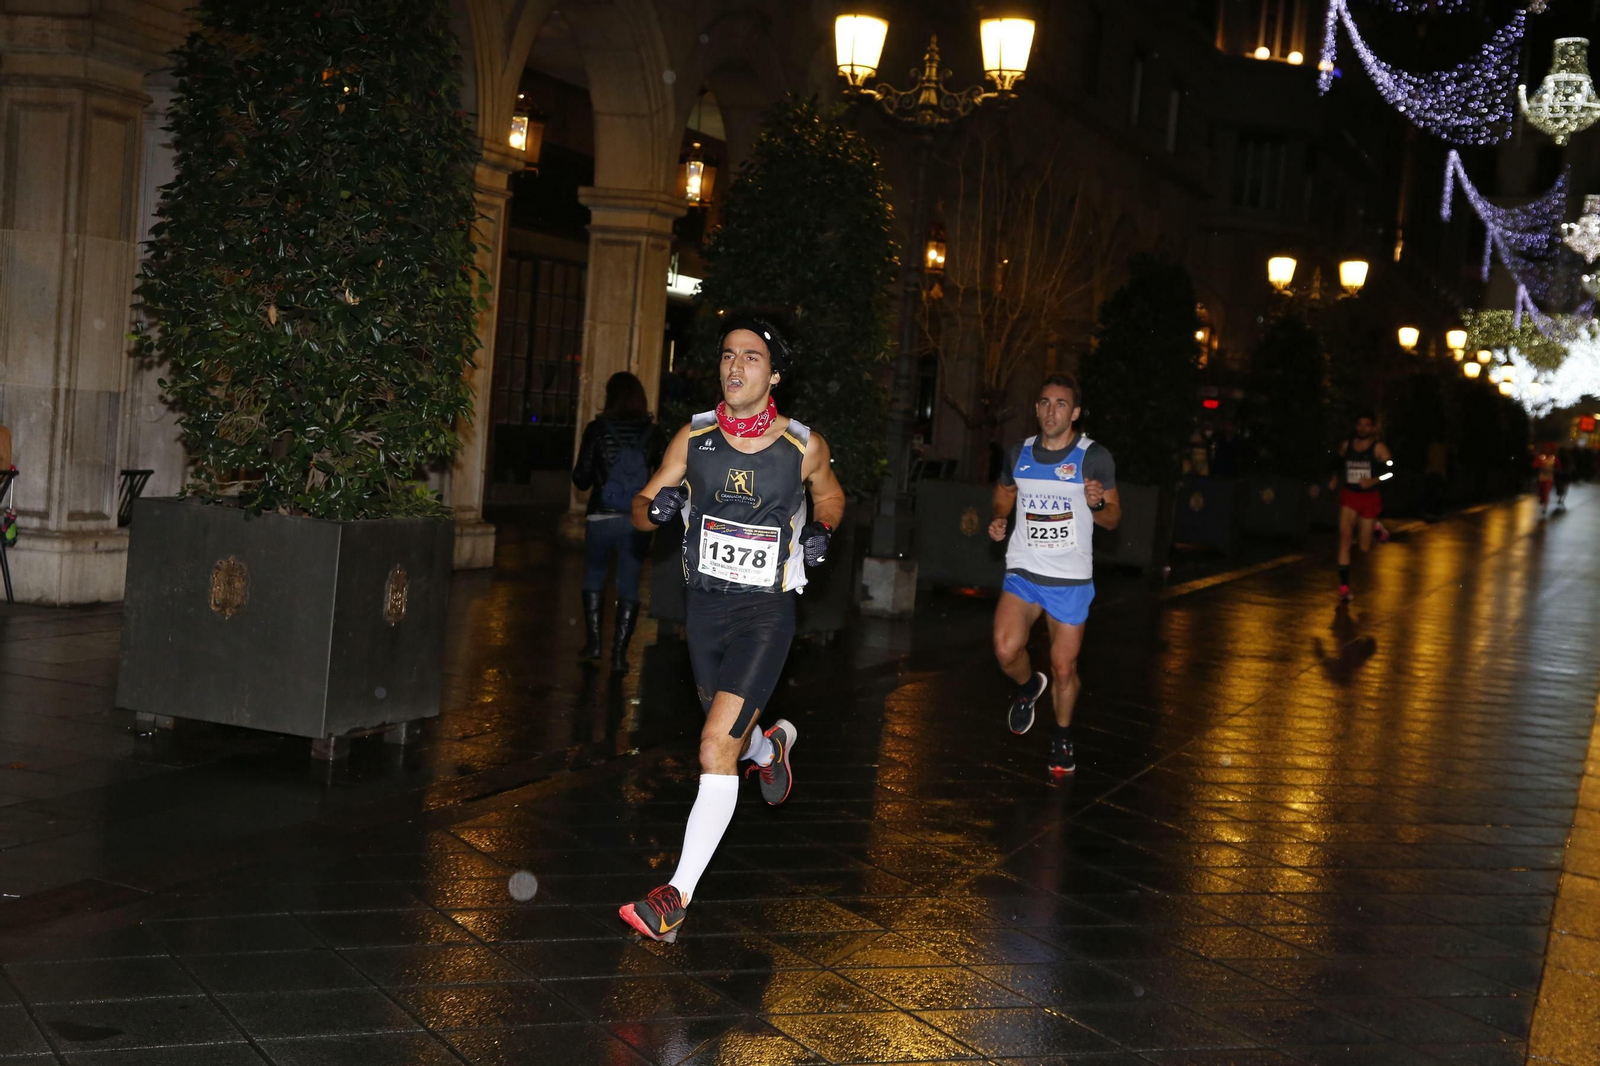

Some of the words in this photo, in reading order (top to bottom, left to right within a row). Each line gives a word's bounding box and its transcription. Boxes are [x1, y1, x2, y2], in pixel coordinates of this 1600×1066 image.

[1035, 494, 1073, 502] ATLETISMO
[1030, 526, 1069, 540] 2235
[709, 541, 766, 569] 1378
